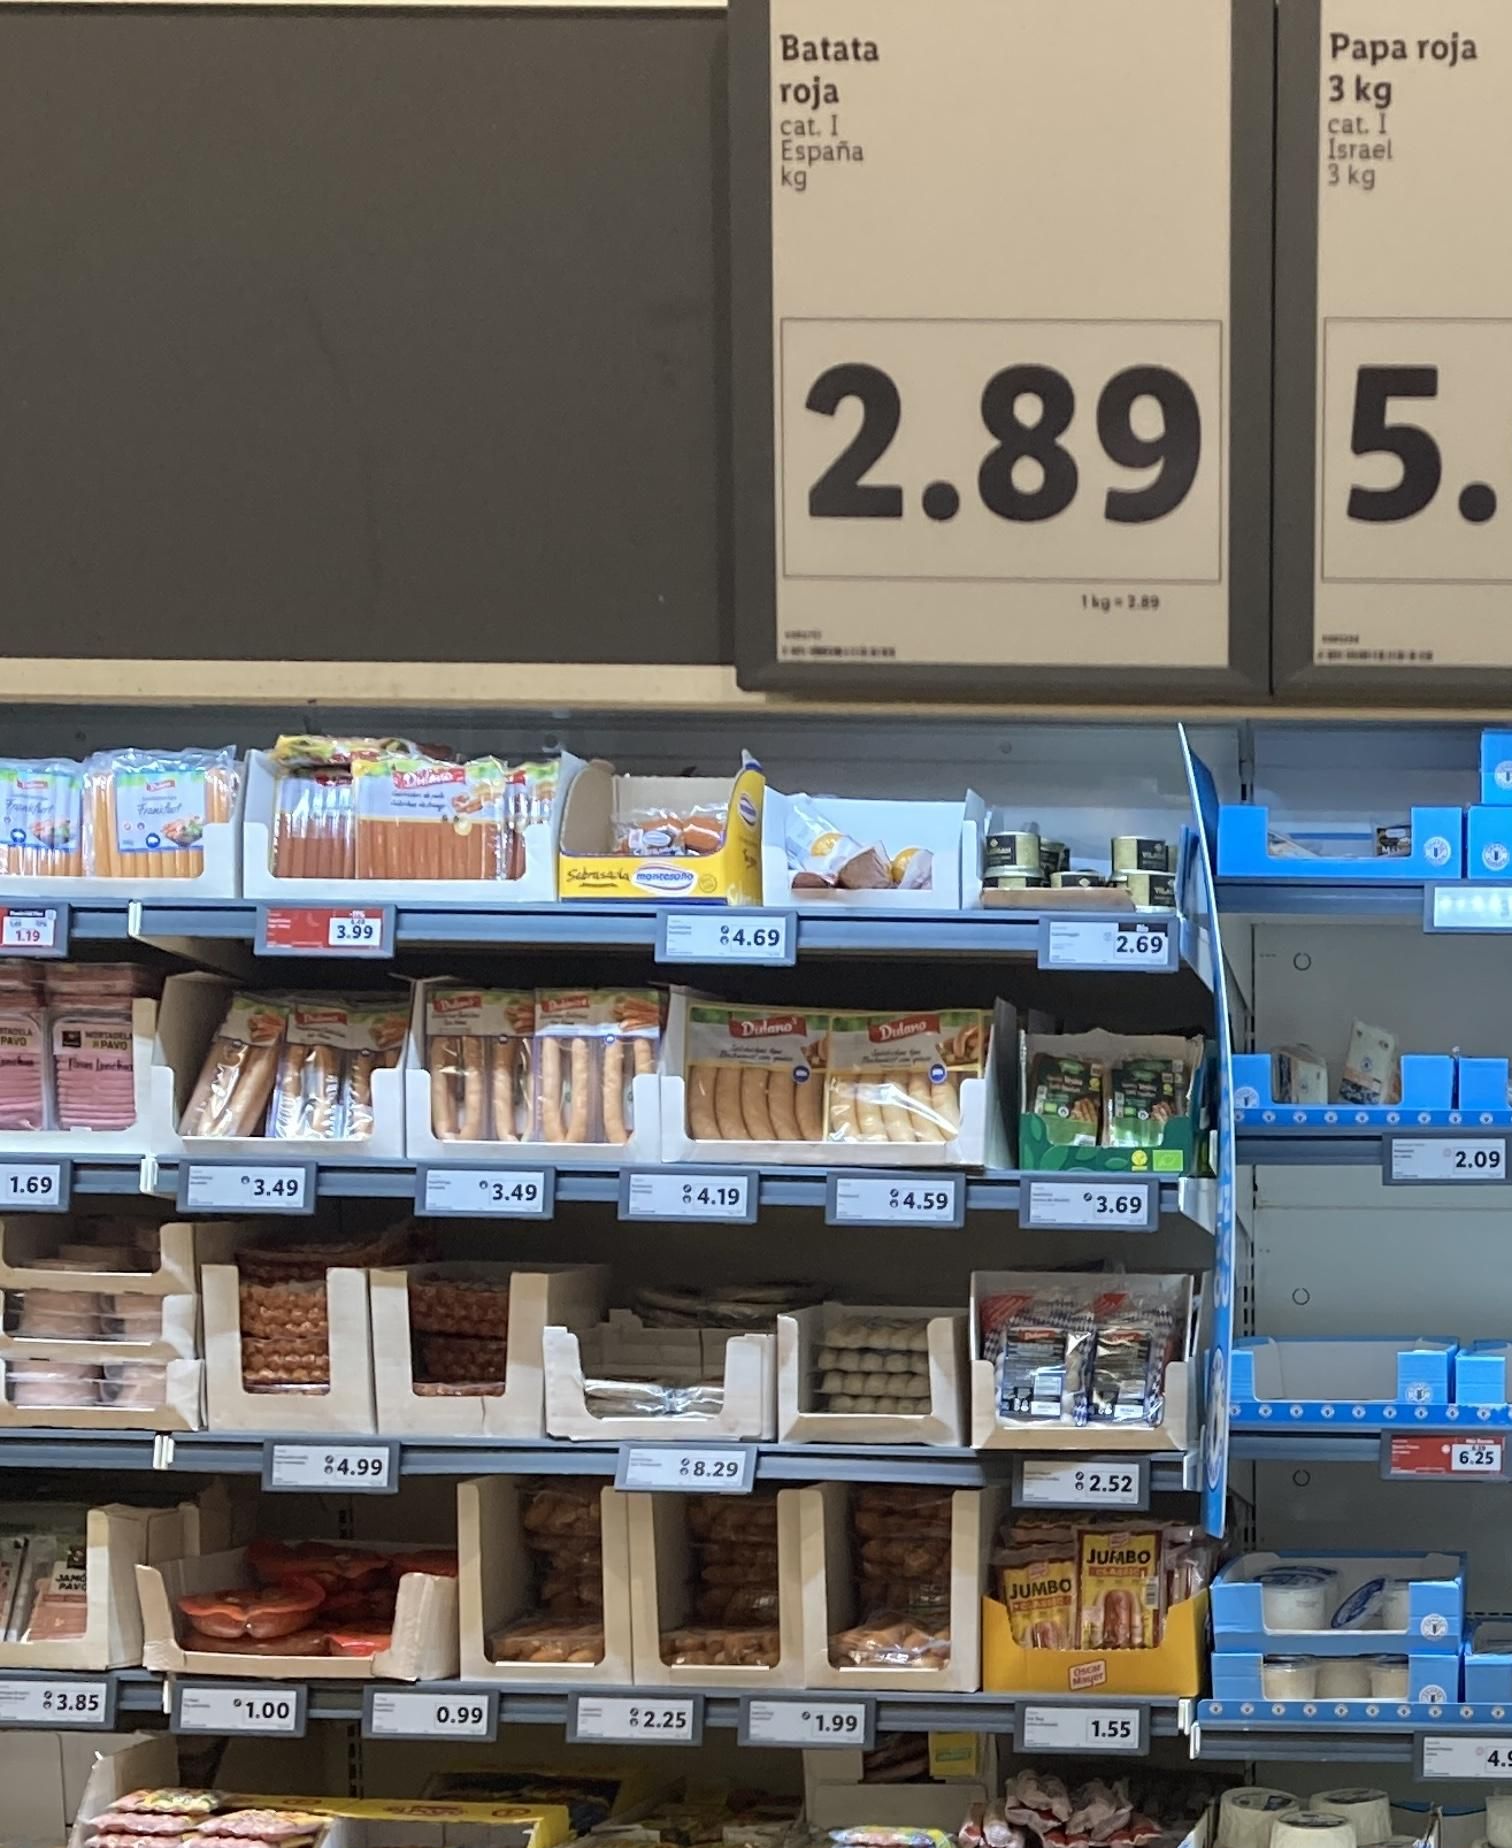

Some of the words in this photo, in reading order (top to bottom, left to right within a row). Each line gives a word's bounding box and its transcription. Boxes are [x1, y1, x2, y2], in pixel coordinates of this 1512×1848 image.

[780, 34, 880, 62] Batata
[1330, 33, 1408, 66] Papa
[1417, 31, 1478, 67] roja
[780, 75, 840, 111] roja
[1328, 74, 1345, 102] 3
[1355, 74, 1393, 109] kg
[780, 117, 822, 137] cat.
[831, 114, 838, 137] I
[1327, 116, 1370, 135] cat.
[1378, 113, 1387, 135] I
[781, 139, 864, 167] España
[1327, 137, 1393, 161] Israel
[781, 166, 807, 192] kg
[1328, 163, 1340, 187] 3
[1348, 164, 1376, 191] kg
[805, 363, 1201, 523] 2.89
[1092, 594, 1111, 612] kg
[16, 930, 40, 942] 1.19
[337, 925, 373, 939] 3.99
[732, 927, 780, 946] 4.69
[1116, 936, 1163, 953] 2.69
[740, 1020, 793, 1037] Dulano
[879, 1020, 927, 1041] Dulano
[100, 1041, 128, 1050] PAVO
[1455, 1150, 1500, 1168] 2.09
[9, 1176, 52, 1194] 1.69
[253, 1179, 299, 1197] 3.49
[492, 1184, 538, 1202] 3.49
[698, 1187, 740, 1206] 4.19
[903, 1192, 948, 1210] 4.59
[1096, 1196, 1142, 1213] 3.69
[1459, 1451, 1494, 1464] 6.25
[336, 1458, 383, 1477] 4.99
[693, 1461, 738, 1478] 8.29
[1089, 1474, 1133, 1493] 2.52
[1087, 1549, 1151, 1564] JUMBO
[1010, 1579, 1072, 1600] JUMBO
[1073, 1664, 1102, 1677] Oscar
[1072, 1673, 1104, 1687] Mayer
[56, 1694, 99, 1712] 3.85
[245, 1701, 290, 1720] 1.00
[436, 1706, 483, 1725] 0.99
[643, 1711, 688, 1729] 2.25
[814, 1714, 858, 1732] 1.99
[1091, 1720, 1132, 1738] 1.55
